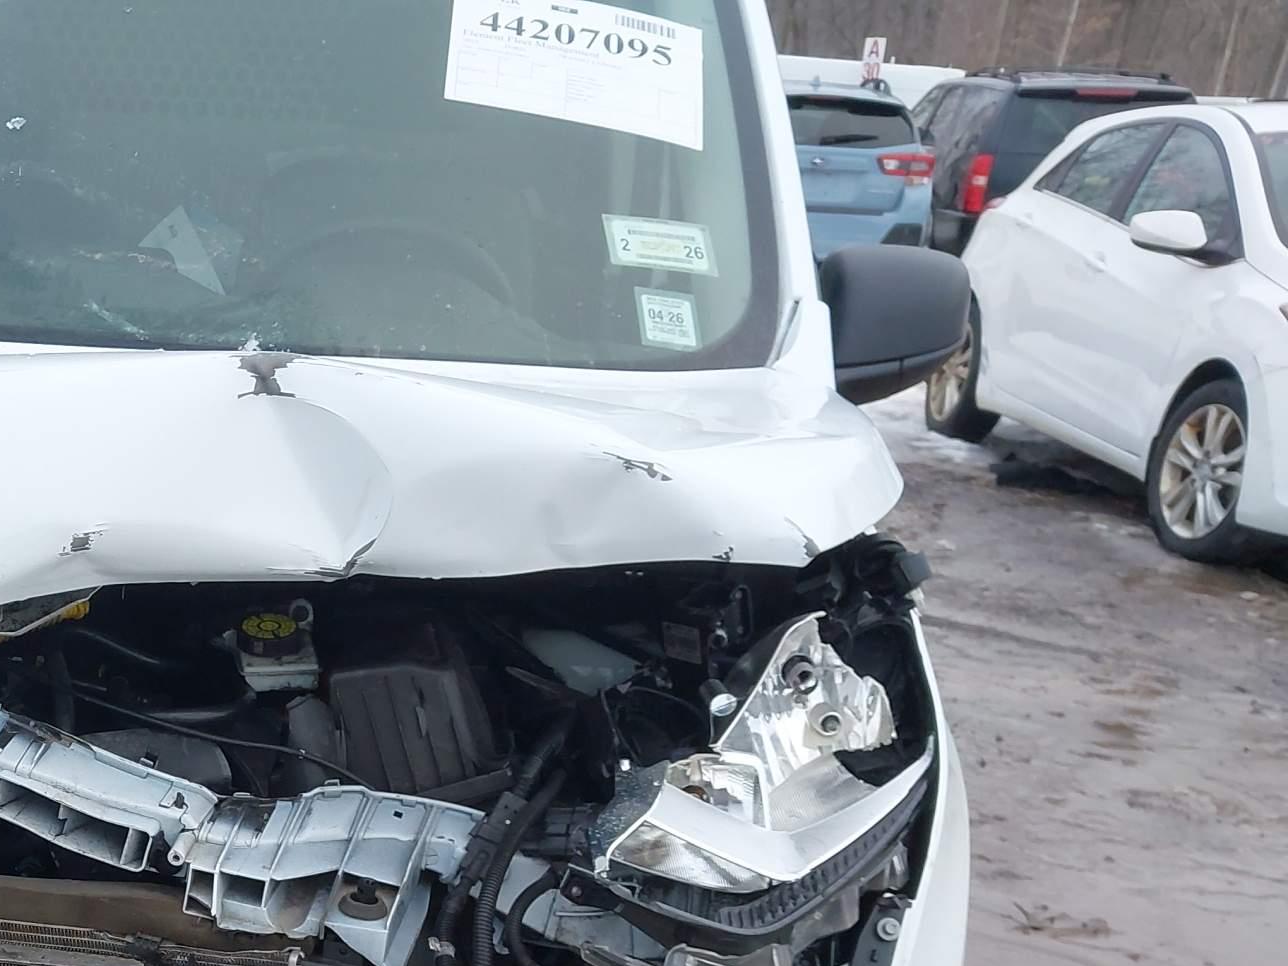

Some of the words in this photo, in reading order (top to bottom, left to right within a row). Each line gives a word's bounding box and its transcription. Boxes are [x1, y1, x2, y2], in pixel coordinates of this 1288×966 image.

[479, 11, 673, 66] 44207095
[868, 39, 879, 58] A
[620, 238, 631, 252] 2
[683, 245, 705, 260] 26
[648, 308, 664, 321] 04
[668, 311, 684, 324] 26
